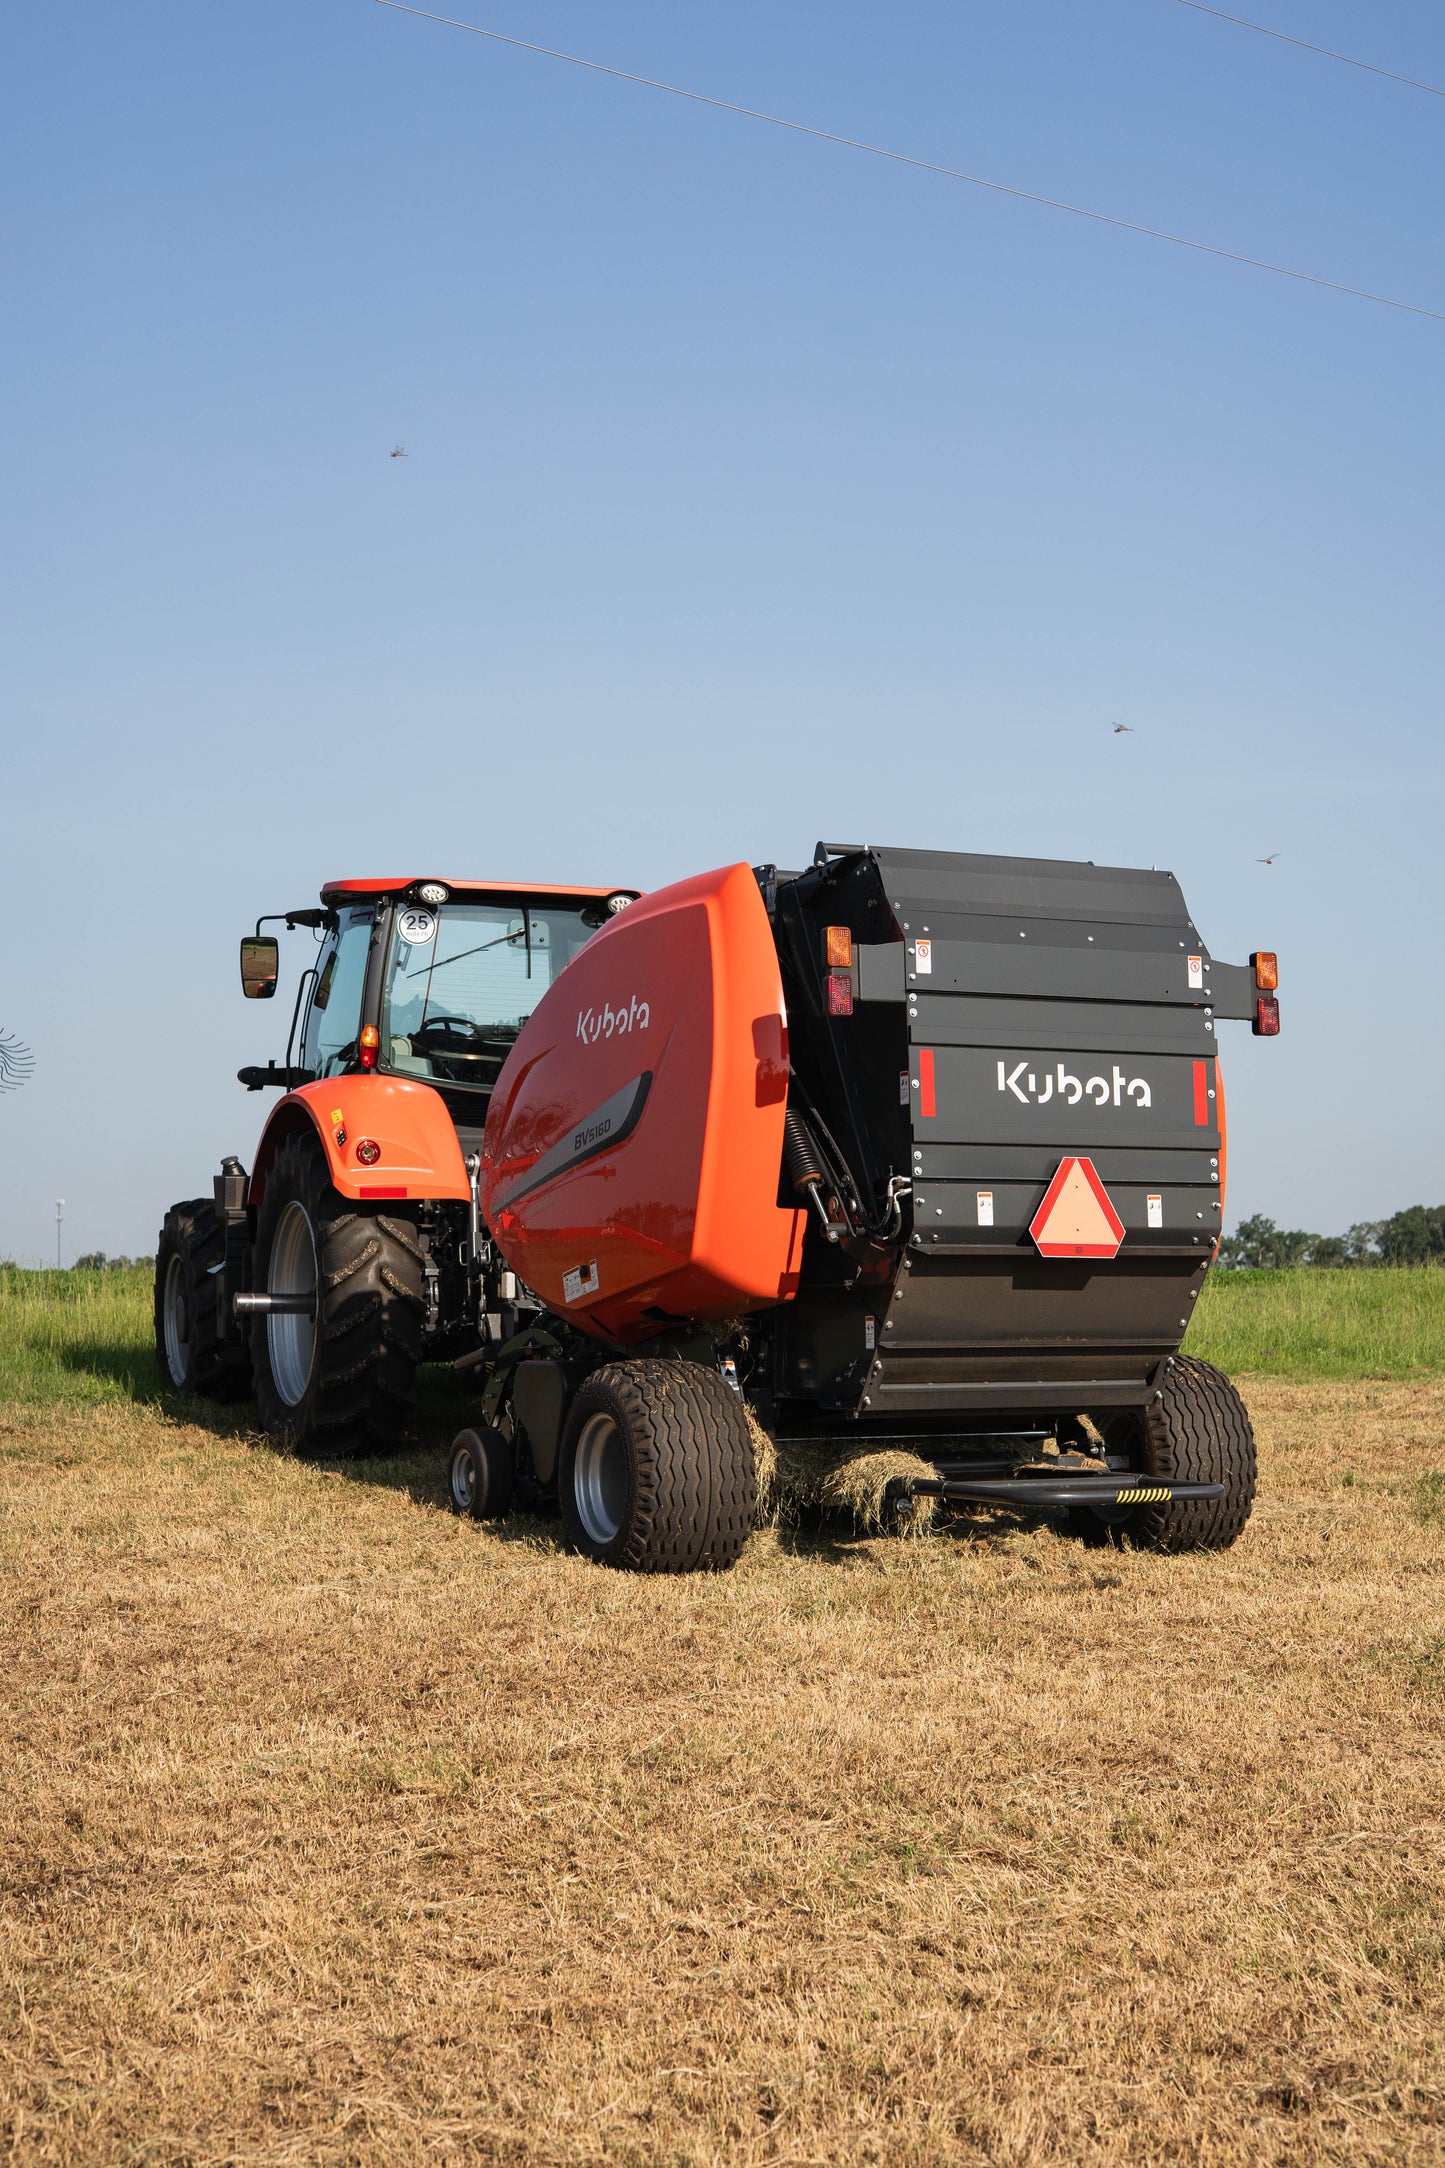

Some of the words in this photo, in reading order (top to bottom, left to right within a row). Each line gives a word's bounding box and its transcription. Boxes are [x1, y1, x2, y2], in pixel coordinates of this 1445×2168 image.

[406, 915, 428, 930] 25
[576, 994, 650, 1045] Kubota
[997, 1061, 1152, 1108] Kubota
[574, 1118, 611, 1151] BV5160
